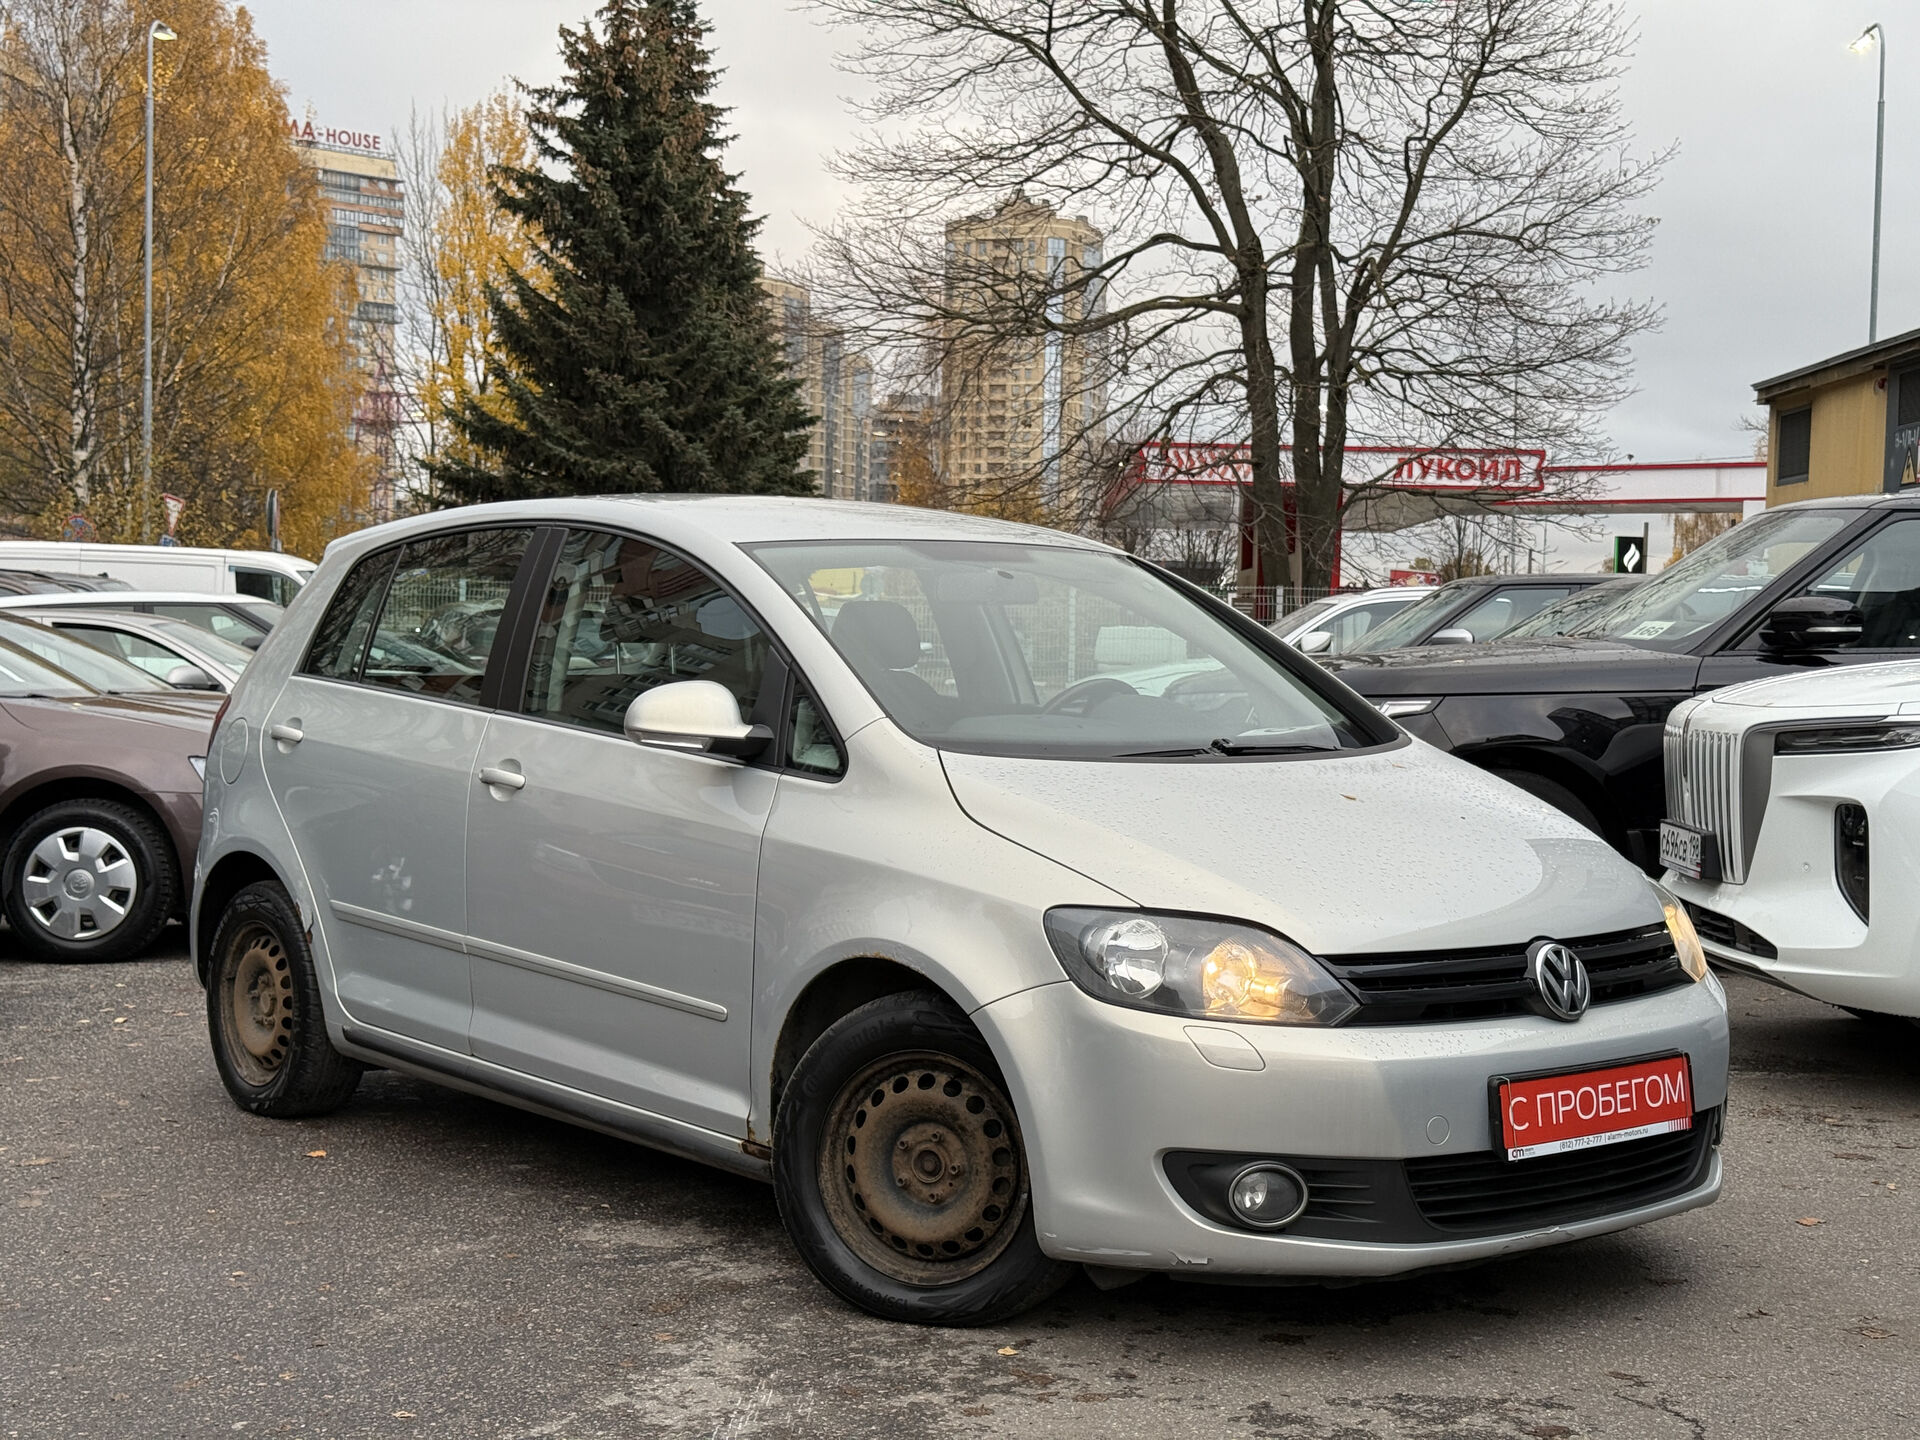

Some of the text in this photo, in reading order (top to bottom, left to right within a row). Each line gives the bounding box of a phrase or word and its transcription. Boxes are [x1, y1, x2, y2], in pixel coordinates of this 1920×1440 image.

[1508, 1070, 1686, 1131] С ПРОБЕГОМ
[1559, 1127, 1649, 1151] (812) 777-2-777 alarm-motors.ru
